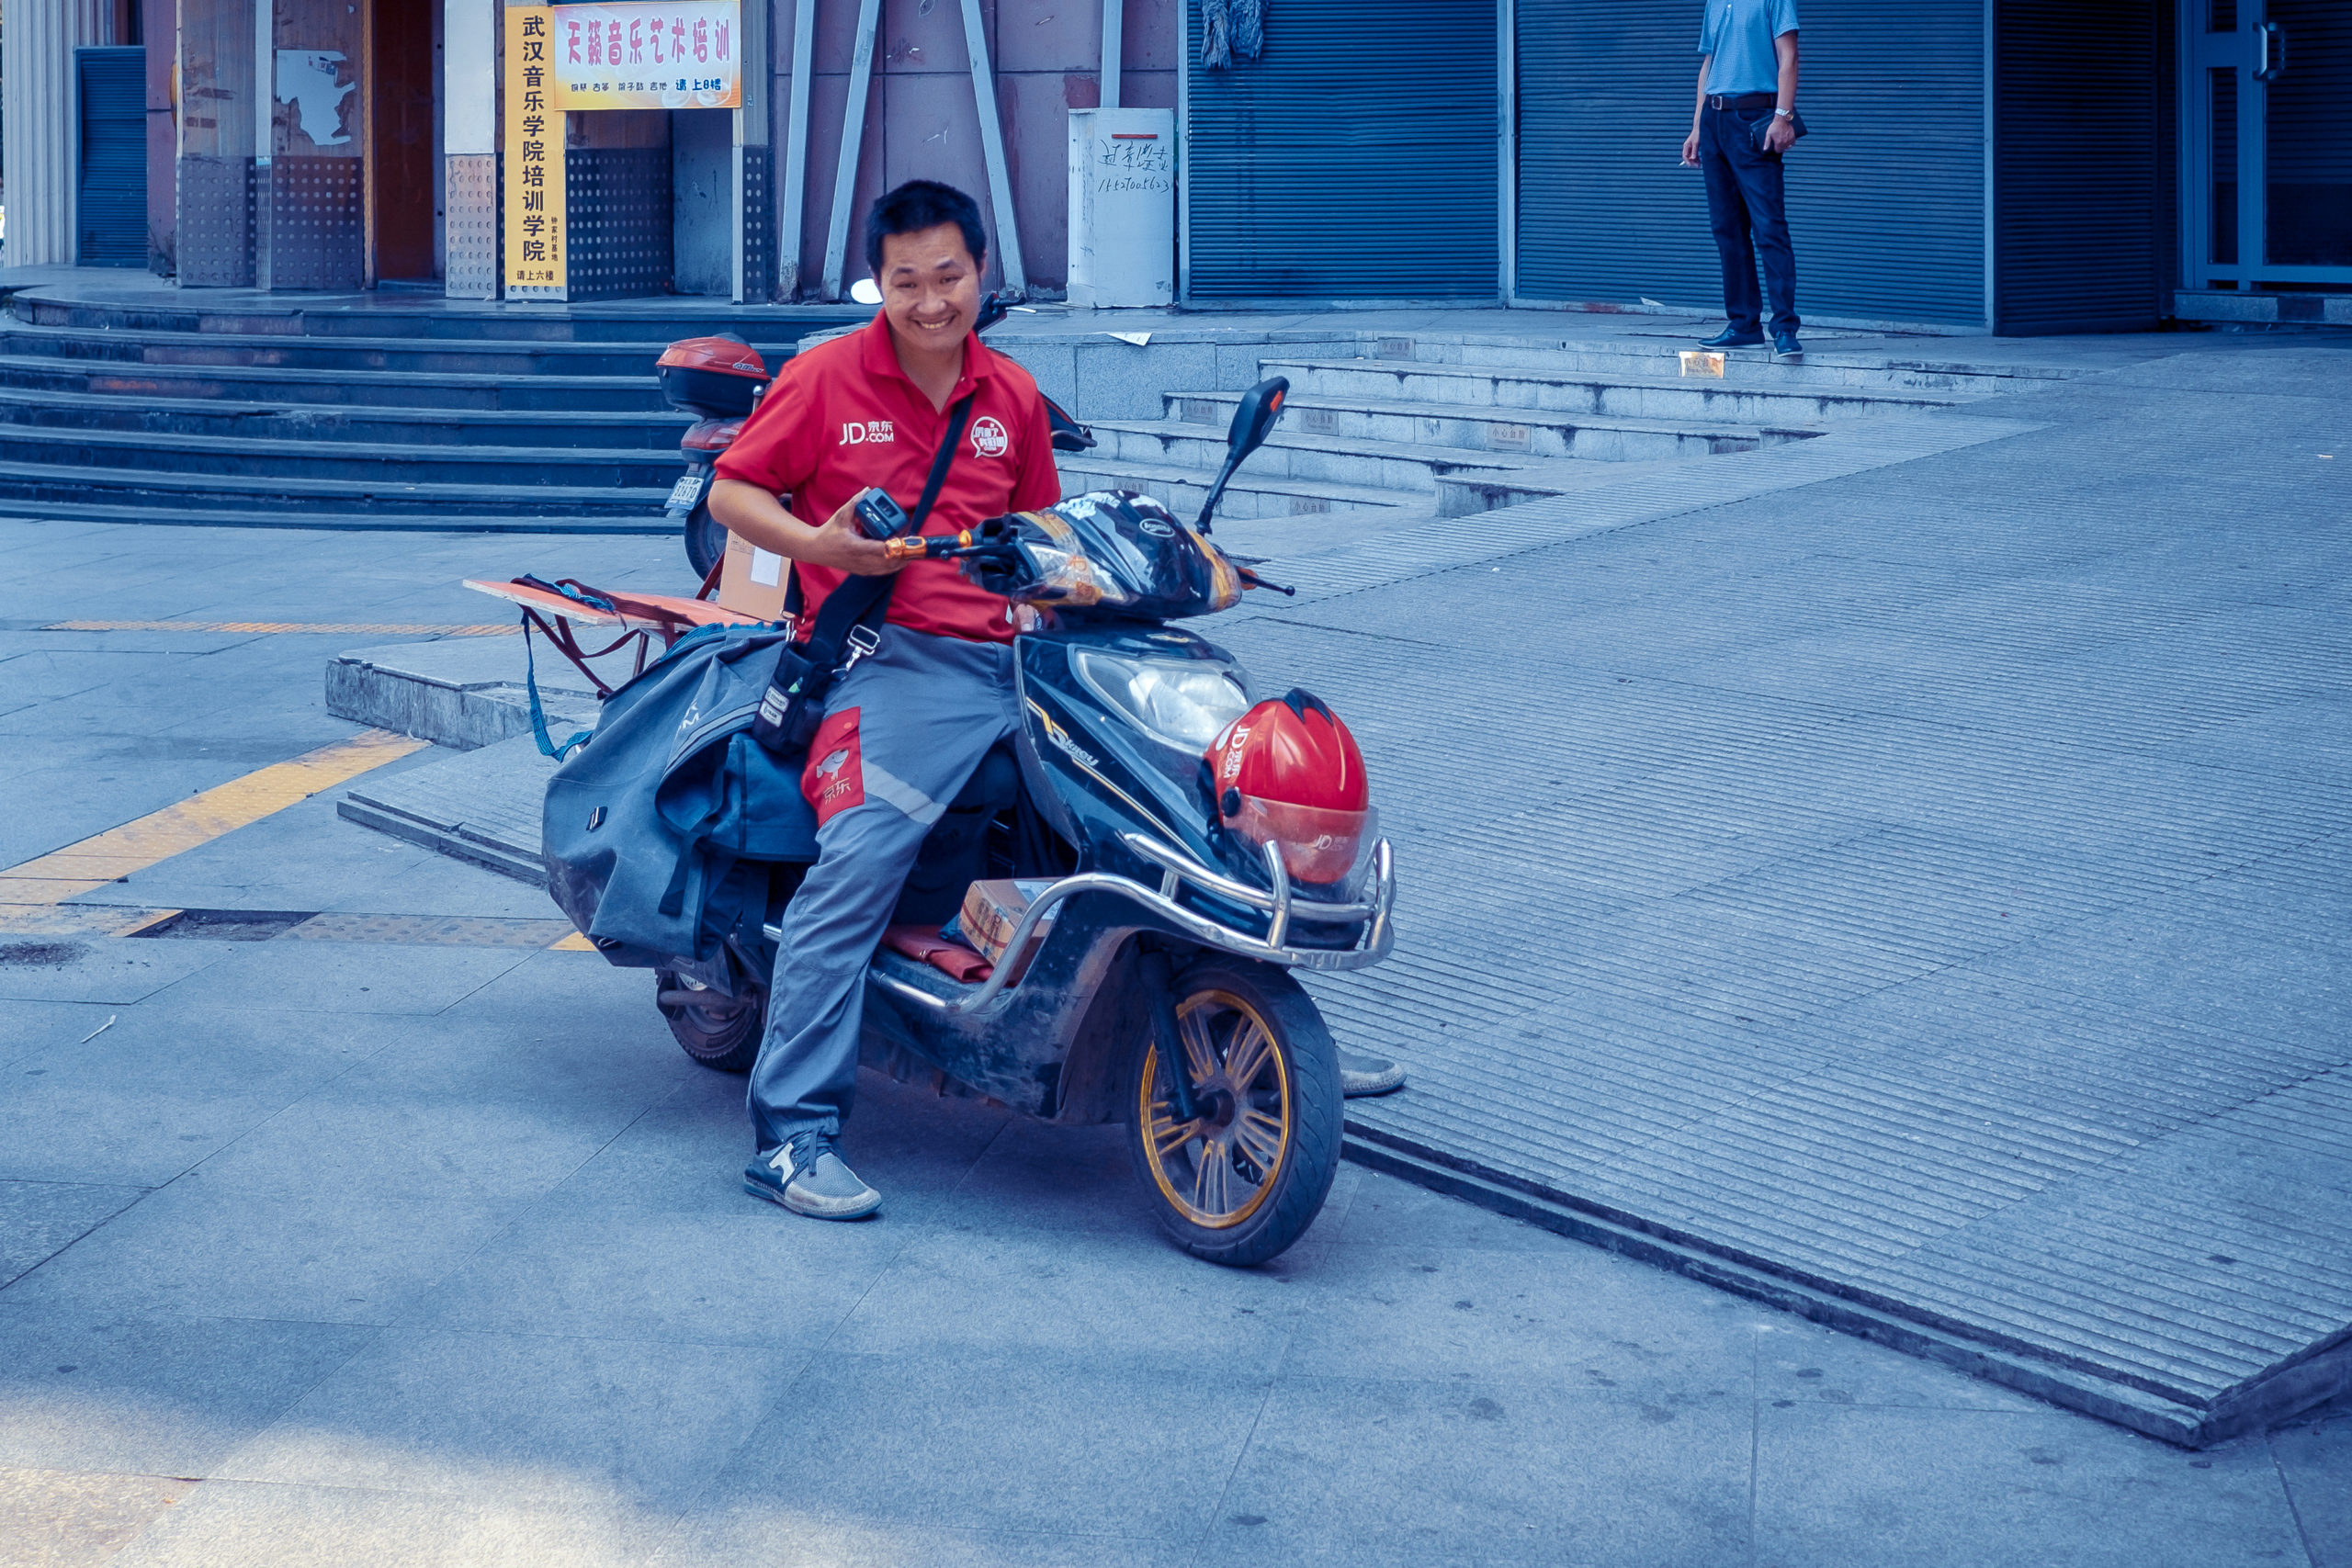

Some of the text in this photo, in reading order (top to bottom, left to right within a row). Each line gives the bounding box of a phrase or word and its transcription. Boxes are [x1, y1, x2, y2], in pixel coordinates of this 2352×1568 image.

[567, 16, 731, 66] 天籁音乐艺术培训
[522, 15, 546, 263] 武汉音乐学院培训学院
[516, 269, 554, 281] 请上六楼
[1492, 426, 1526, 440] 小心台阶
[823, 777, 852, 806] 京东
